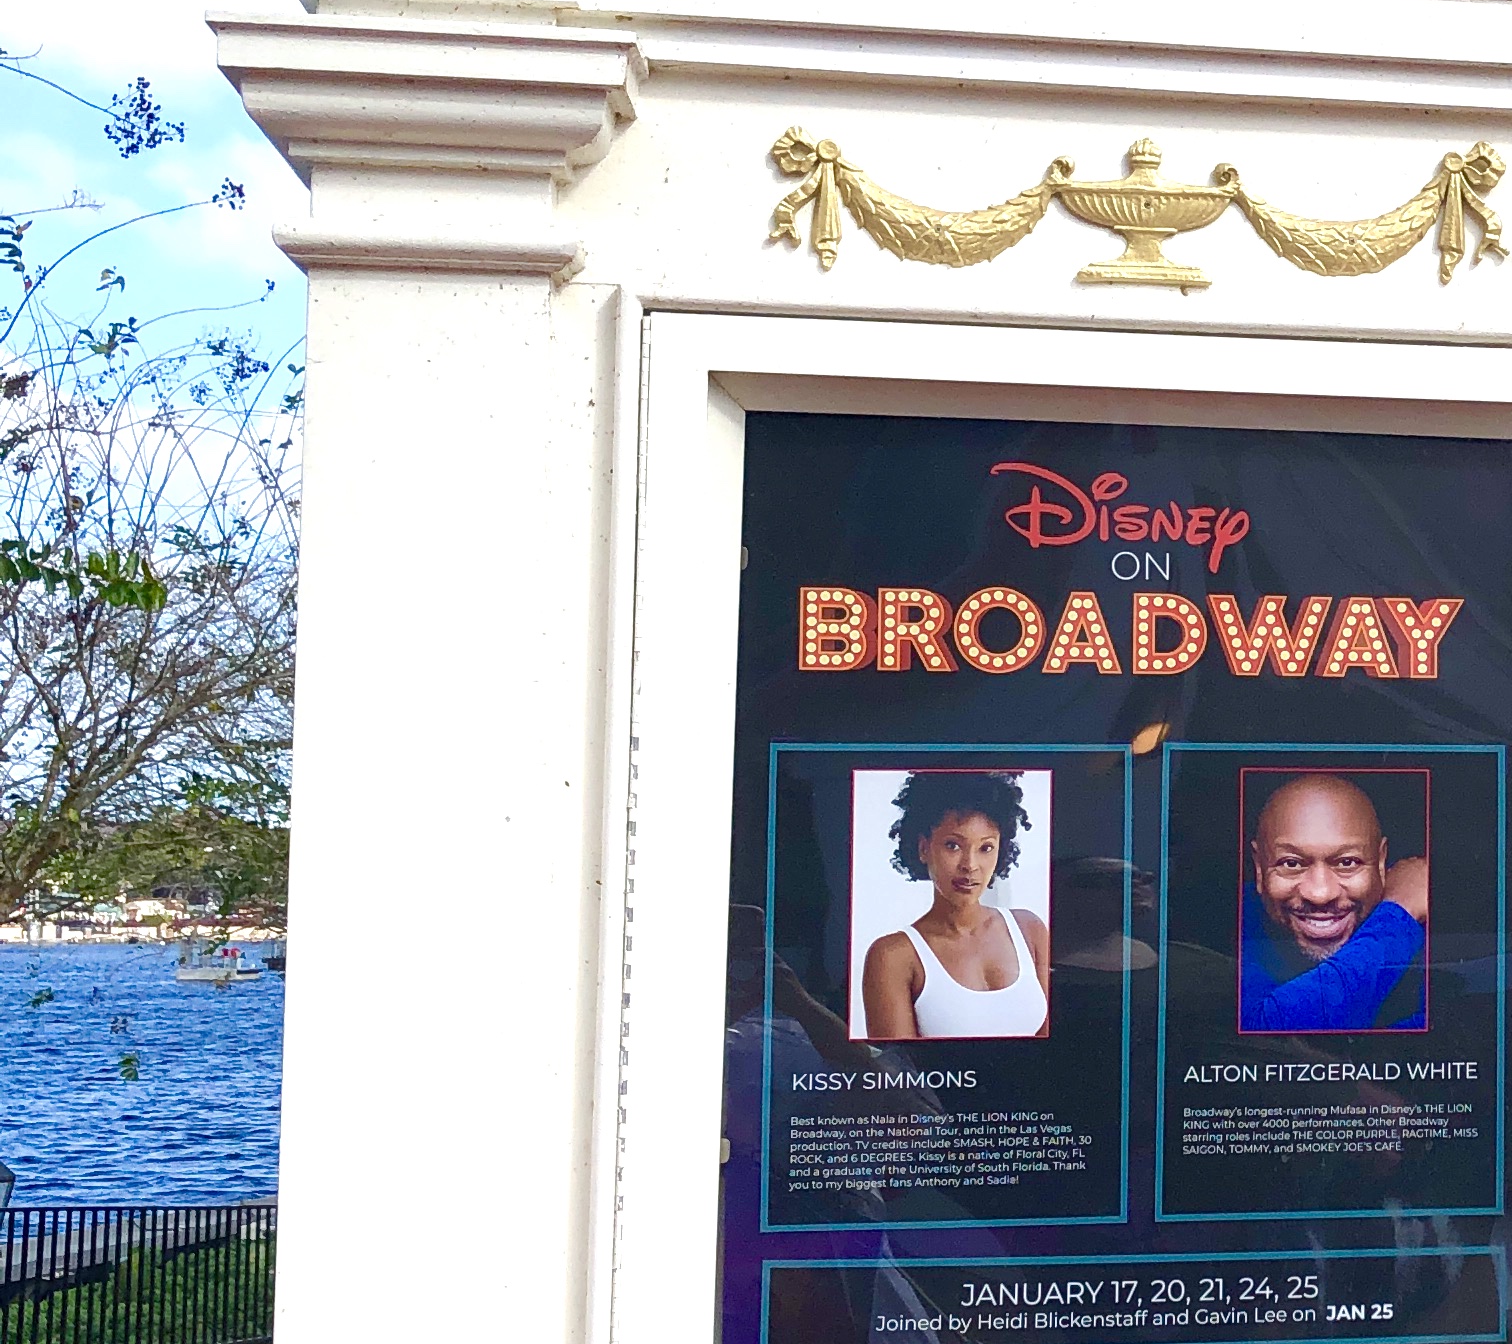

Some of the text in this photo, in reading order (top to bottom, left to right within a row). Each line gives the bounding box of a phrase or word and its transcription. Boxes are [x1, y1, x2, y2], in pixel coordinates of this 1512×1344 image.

[1110, 550, 1171, 581] ON
[799, 586, 1465, 678] BROADWAY
[793, 1070, 977, 1090] KISSY SIMMONS
[1184, 1062, 1478, 1082] ALTON FITZGERALD WHITE
[791, 1117, 814, 1126] Best
[818, 1116, 855, 1125] known
[857, 1117, 869, 1125] as
[871, 1115, 895, 1124] Nala
[898, 1114, 908, 1123] in
[911, 1113, 954, 1125] Disney's
[957, 1113, 979, 1122] THE
[981, 1113, 1008, 1122] LION
[1011, 1112, 1038, 1121] KING
[1184, 1104, 1472, 1118] Broadway's longest-running Mufasa in Disney's THE LION
[791, 1124, 1072, 1139] Broadway, on the National Tour, and in the Las Vegas
[1184, 1117, 1449, 1129] KING with over 4000 performances. Other Broadway
[1183, 1128, 1478, 1143] starring roles include THE COLOR PURPLE, RAGTIME, MISS
[790, 1142, 853, 1153] production.
[872, 1140, 908, 1149] credits
[911, 1139, 951, 1149] include
[953, 1138, 995, 1148] SMASH,
[998, 1137, 1030, 1147] HOPE
[1032, 1138, 1040, 1146] &
[1079, 1136, 1092, 1145] 30
[1183, 1145, 1227, 1155] SAIGON,
[1229, 1144, 1271, 1154] TOMMY,
[1274, 1144, 1294, 1153] and
[1296, 1143, 1341, 1153] SMOKEY
[1343, 1142, 1372, 1152] JOE'S
[790, 1154, 825, 1165] ROCK,
[827, 1153, 848, 1163] and
[851, 1153, 858, 1162] 6
[861, 1152, 917, 1162] DEGREES.
[919, 1152, 945, 1163] Kissy
[948, 1151, 956, 1161] is
[968, 1151, 1000, 1161] native
[1003, 1150, 1014, 1159] of
[1016, 1149, 1045, 1159] Floral
[1072, 1149, 1085, 1158] FL
[789, 1167, 810, 1177] and
[822, 1166, 872, 1178] graduate
[875, 1165, 885, 1174] of
[888, 1165, 906, 1174] the
[909, 1163, 962, 1176] University
[965, 1163, 976, 1173] of
[978, 1162, 1010, 1172] South
[1053, 1161, 1086, 1171] Thank
[789, 1175, 1019, 1192] you to my biggest fans Anthony and Sadie!
[961, 1276, 1319, 1307] JANUARY 17, 20, 21, 24, 25
[876, 1304, 1393, 1333] Joined by Heidi Blickenstaff and Gavin Lee on JAN 25
